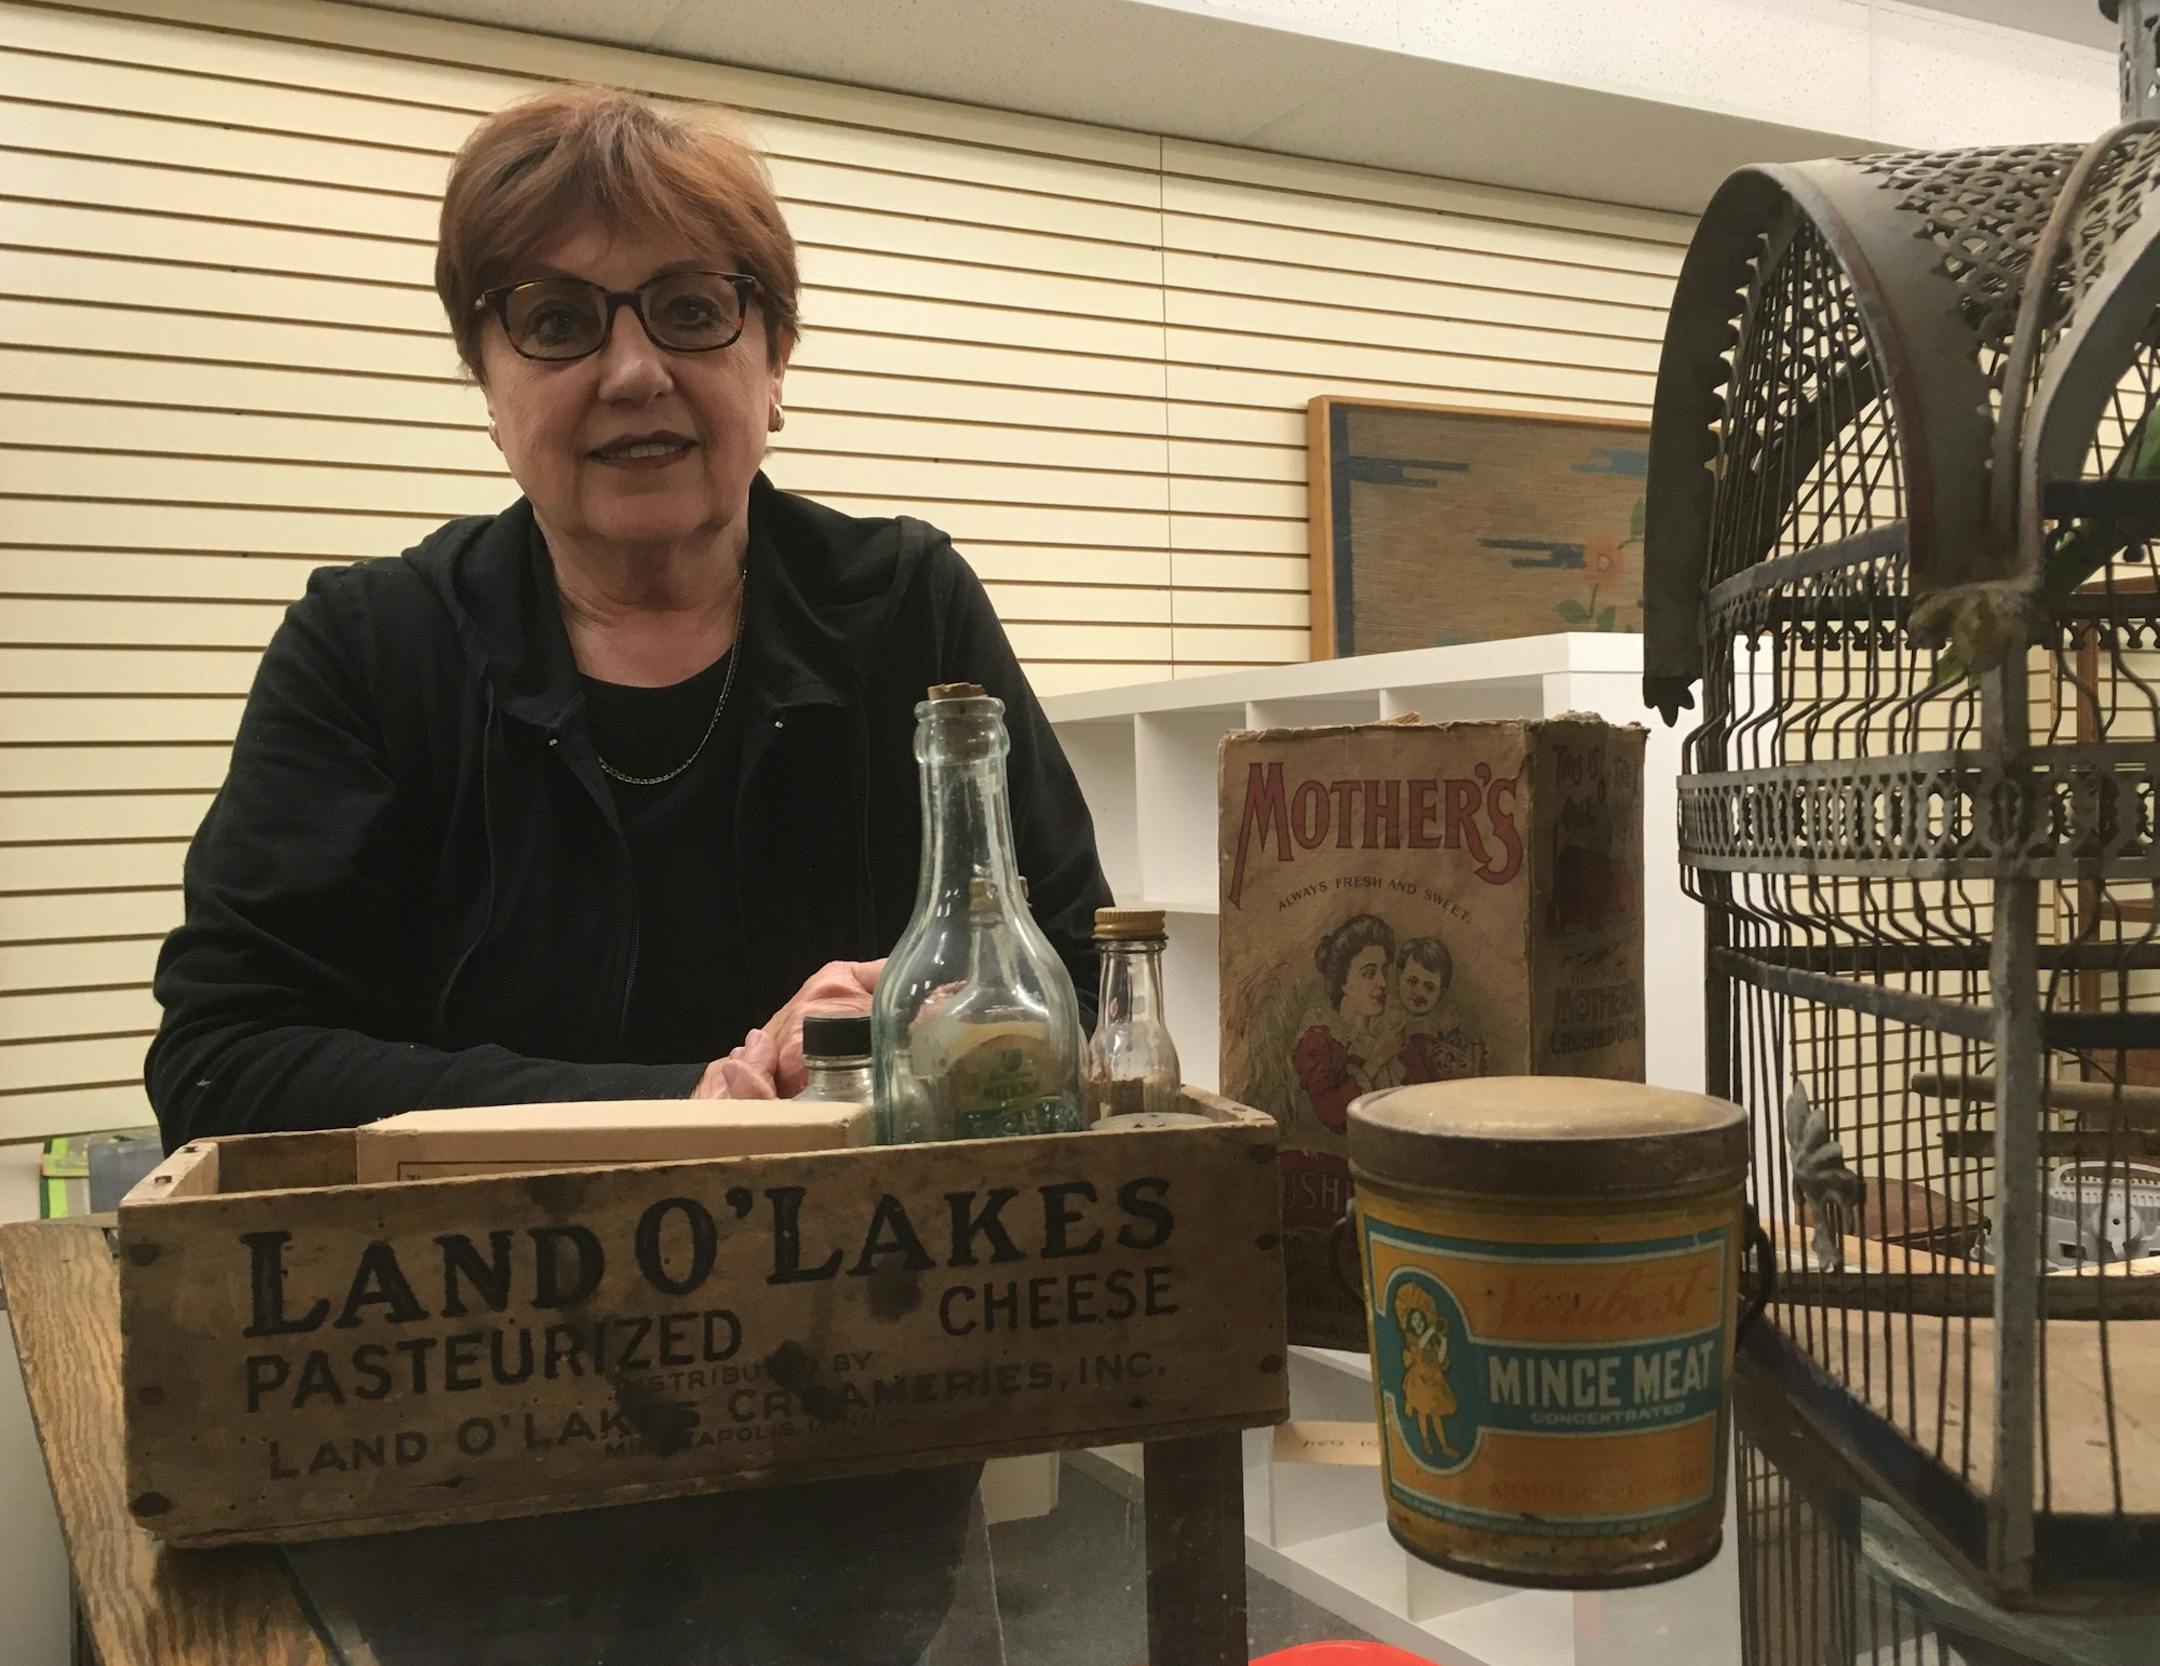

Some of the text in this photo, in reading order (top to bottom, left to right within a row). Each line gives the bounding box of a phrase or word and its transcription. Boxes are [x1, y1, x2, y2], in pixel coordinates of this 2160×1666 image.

[1228, 762, 1523, 910] MOTHER'S
[1277, 880, 1329, 913] ALWAYS
[1335, 874, 1383, 889] FRESH
[1387, 878, 1418, 896] AND
[239, 1176, 1176, 1338] LAND O'LAKES
[938, 1266, 1179, 1338] CHEESE
[244, 1308, 743, 1414] PASTEURIZED
[834, 1350, 874, 1373] BY
[1488, 1339, 1715, 1408] MINCE MEAT
[267, 1431, 428, 1481] LAND
[1080, 1351, 1165, 1385] INC.
[1530, 1401, 1687, 1426] CONCENTRATED
